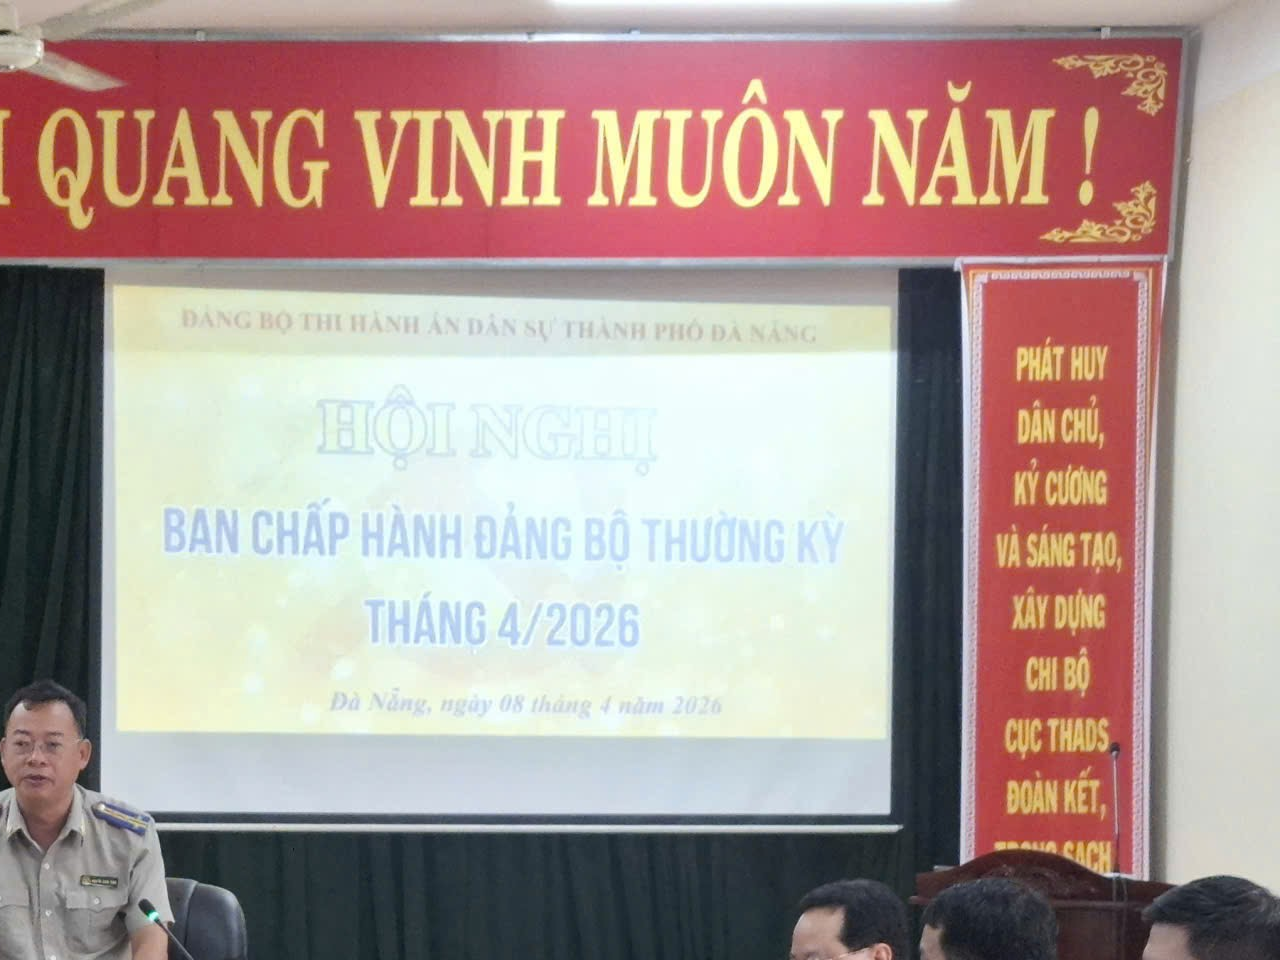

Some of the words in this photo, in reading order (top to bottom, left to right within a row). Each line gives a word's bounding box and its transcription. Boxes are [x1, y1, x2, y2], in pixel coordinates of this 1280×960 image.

[39, 109, 329, 229] QUANG
[354, 109, 566, 208] VINH
[587, 78, 844, 209] MUÔN
[862, 81, 1055, 206] NĂM
[259, 309, 293, 334] BỘ
[299, 311, 345, 332] THI
[350, 308, 419, 335] HÀNH
[562, 314, 646, 341] THÀNH
[1016, 336, 1064, 381] PHÁT
[1070, 346, 1108, 381] HUY
[317, 383, 456, 471] HỘI
[470, 403, 658, 476] NGHỊ
[1017, 400, 1056, 444] DÂN
[1061, 394, 1104, 450] CHỦ,
[1014, 458, 1040, 505] KỶ
[1045, 464, 1108, 505] CƯƠNG
[163, 507, 239, 554] BAN
[251, 498, 350, 557] CHẤP
[361, 504, 462, 558] HÀNH
[475, 501, 571, 561] ĐẢNG
[584, 508, 631, 571] BỘ
[641, 510, 785, 563] THƯỜNG
[797, 511, 845, 563] KỲ
[996, 523, 1020, 568] VÀ
[1026, 523, 1076, 568] SÁNG
[1080, 532, 1122, 574] TẠO,
[365, 591, 487, 644] THÁNG
[498, 602, 640, 647] 4/2026
[1012, 585, 1049, 630] XÂY
[1054, 588, 1106, 636] DỰNG
[1026, 656, 1057, 691] CHI
[1063, 647, 1090, 697] BỘ
[499, 694, 525, 713] 08
[599, 696, 612, 714] 4
[671, 696, 723, 715] 2026
[1005, 718, 1042, 760] CỤC
[1047, 717, 1110, 752] THADS
[1007, 771, 1058, 813] ĐOÀN
[1063, 765, 1107, 821] KẾT,
